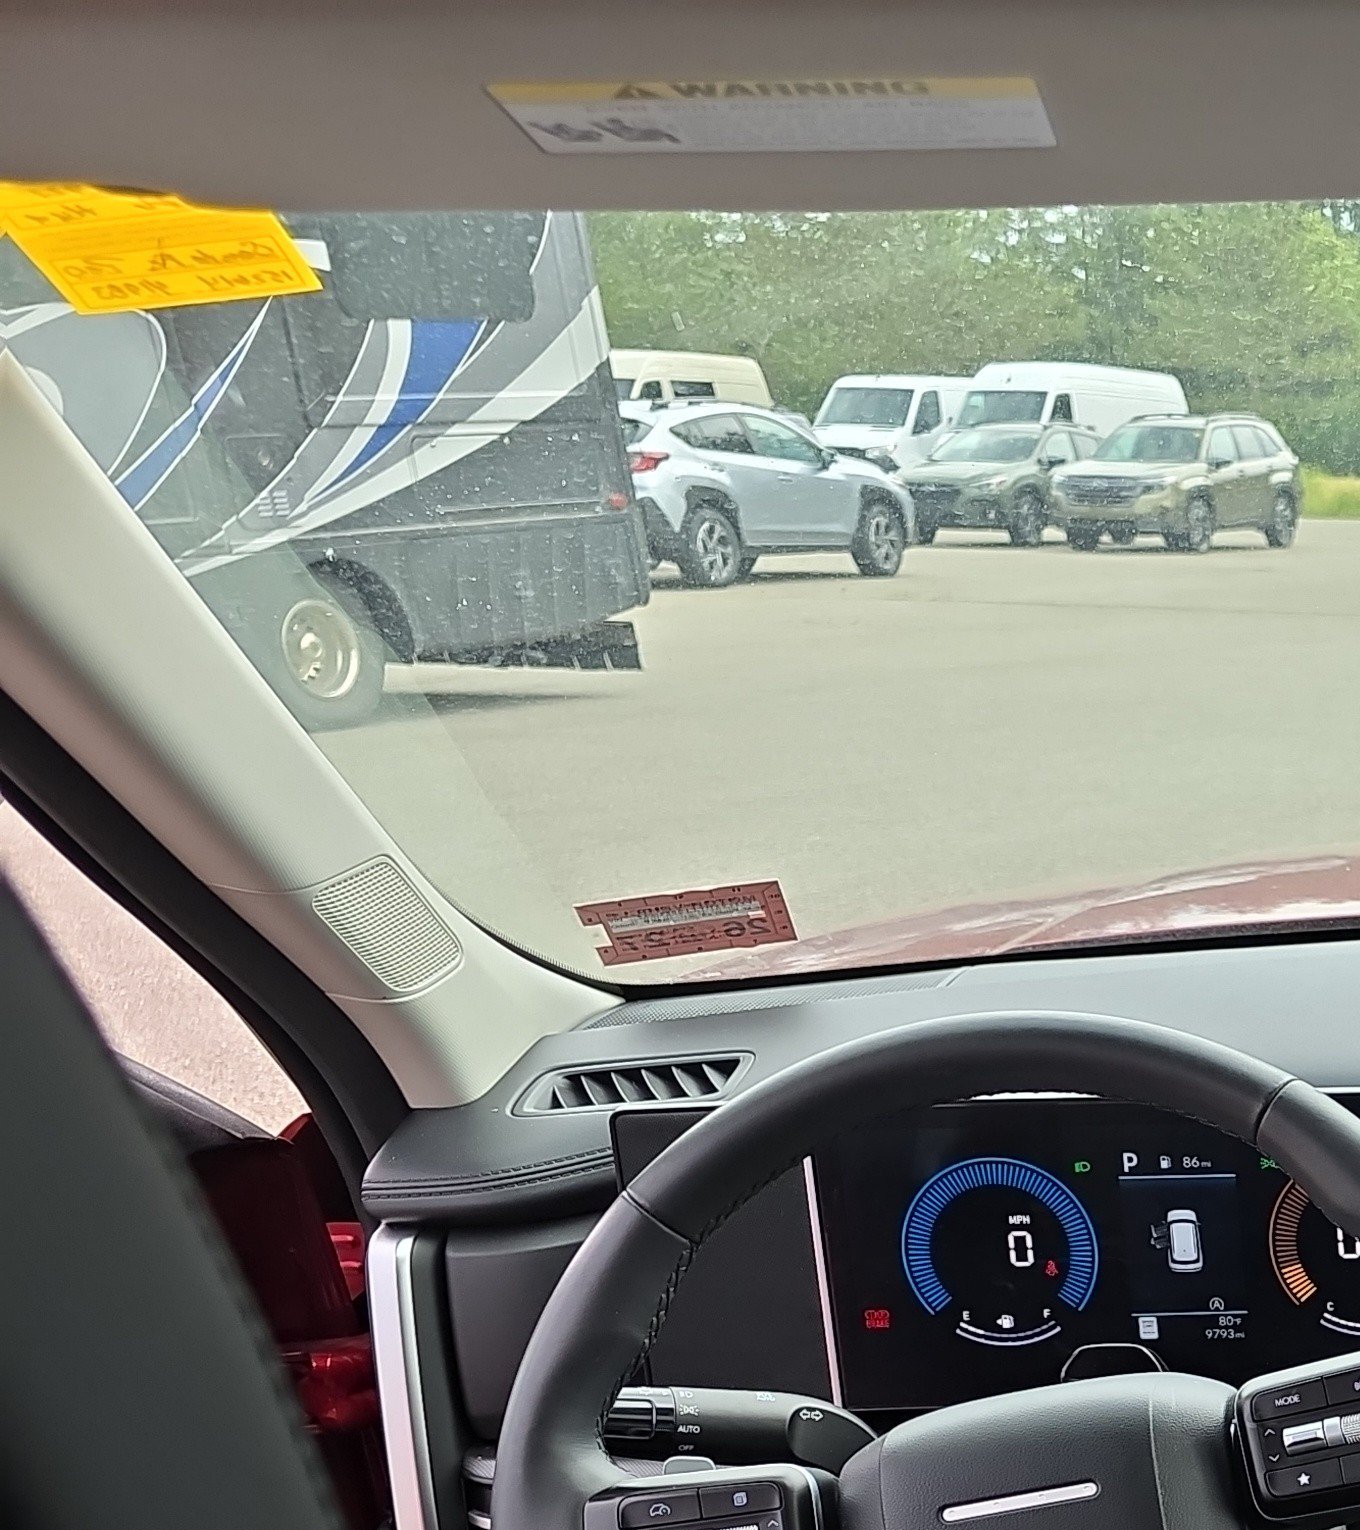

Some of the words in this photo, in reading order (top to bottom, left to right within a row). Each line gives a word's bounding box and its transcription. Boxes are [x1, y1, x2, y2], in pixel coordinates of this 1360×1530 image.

[669, 81, 931, 99] WARNING
[1122, 1152, 1137, 1172] P
[1008, 1215, 1030, 1225] MPH
[1007, 1231, 1034, 1267] 0
[1326, 1300, 1334, 1311] C
[962, 1311, 970, 1321] E
[1043, 1309, 1050, 1319] F
[1274, 1394, 1301, 1408] MODE
[677, 1424, 701, 1435] AUTO
[678, 1444, 695, 1452] OFF
